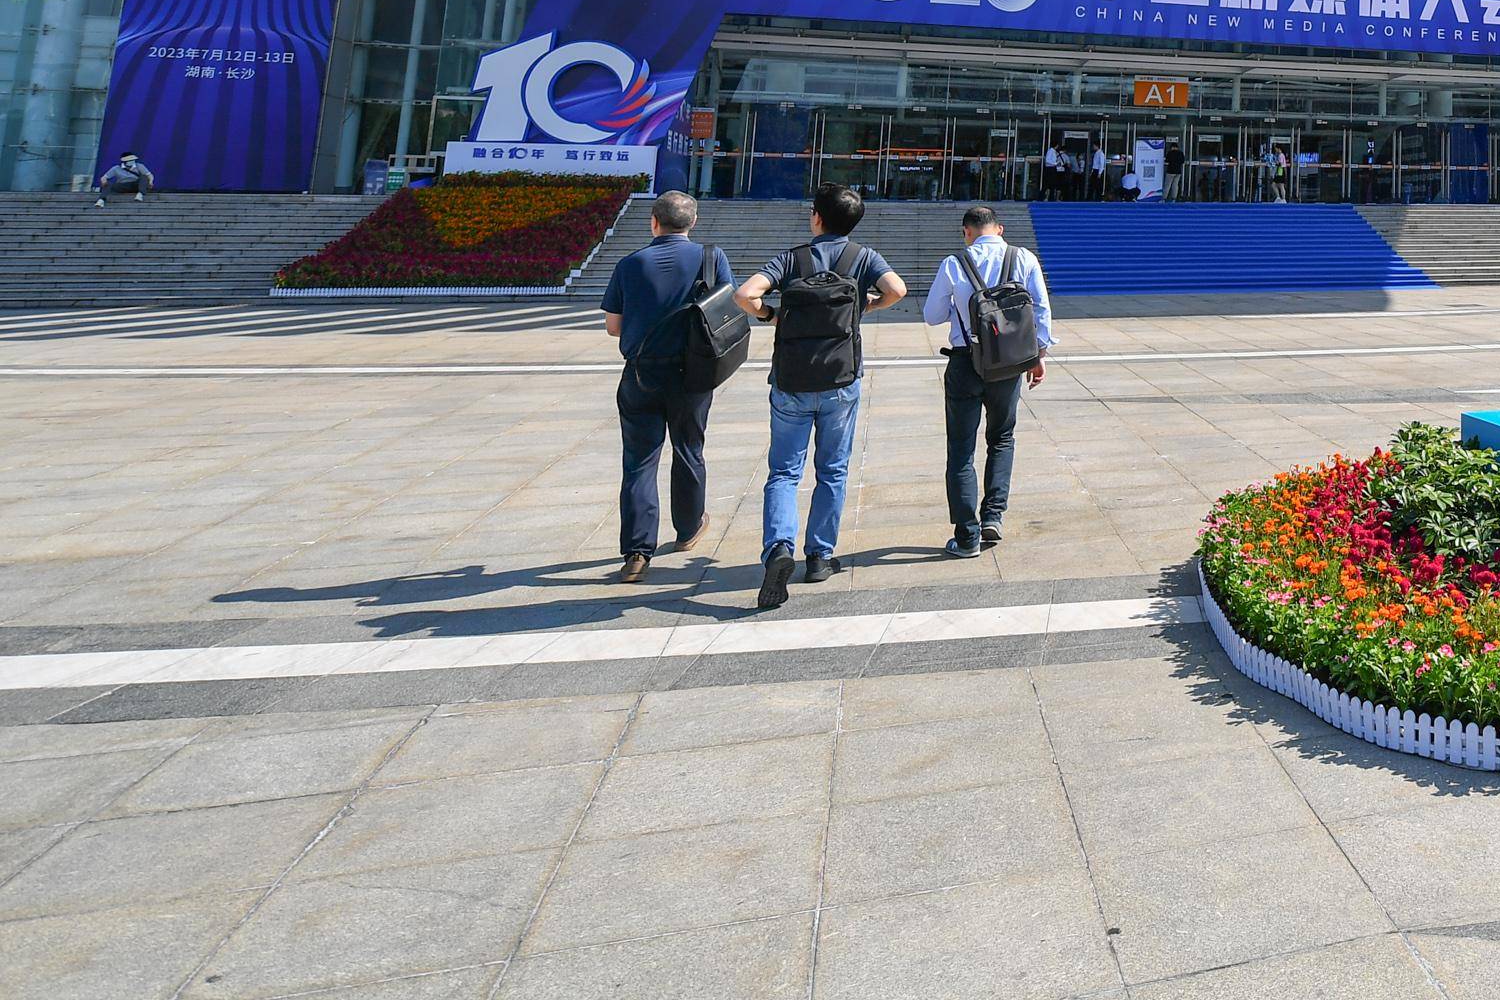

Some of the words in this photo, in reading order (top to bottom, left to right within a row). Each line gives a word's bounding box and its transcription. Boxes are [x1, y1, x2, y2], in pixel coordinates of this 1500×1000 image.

[1075, 5, 1164, 24] CHINA
[1187, 13, 1241, 28] NEW
[1263, 18, 1345, 34] MEDIA
[148, 46, 295, 64] 2023年7月12日-13日
[184, 65, 256, 80] 湖南·长沙
[1144, 83, 1176, 104] A1
[472, 146, 545, 161] 融合10年
[565, 150, 630, 162] 笃行致远
